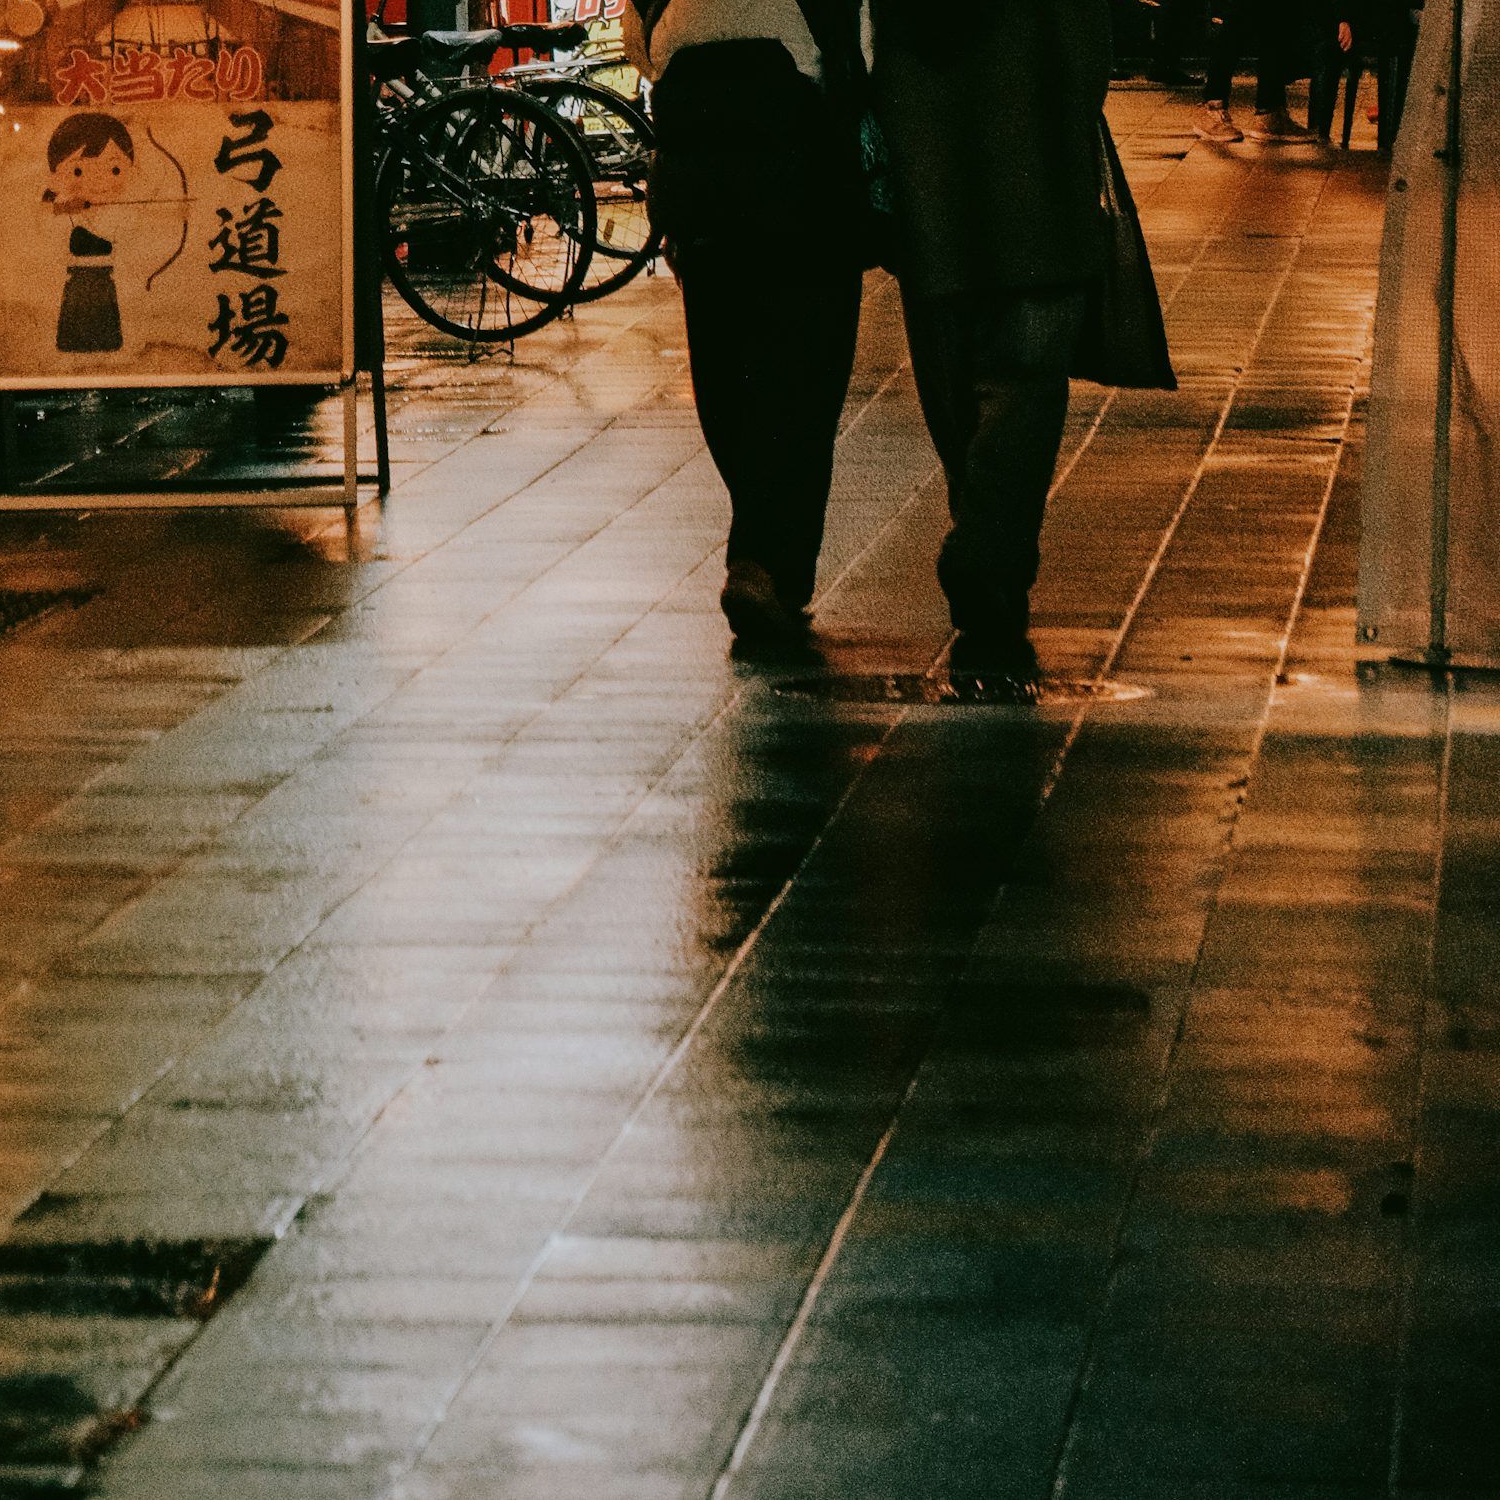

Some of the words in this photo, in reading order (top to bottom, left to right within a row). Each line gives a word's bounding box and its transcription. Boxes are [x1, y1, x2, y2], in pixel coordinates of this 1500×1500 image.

[55, 46, 264, 106] 大当たり
[206, 109, 290, 369] 弓道場
